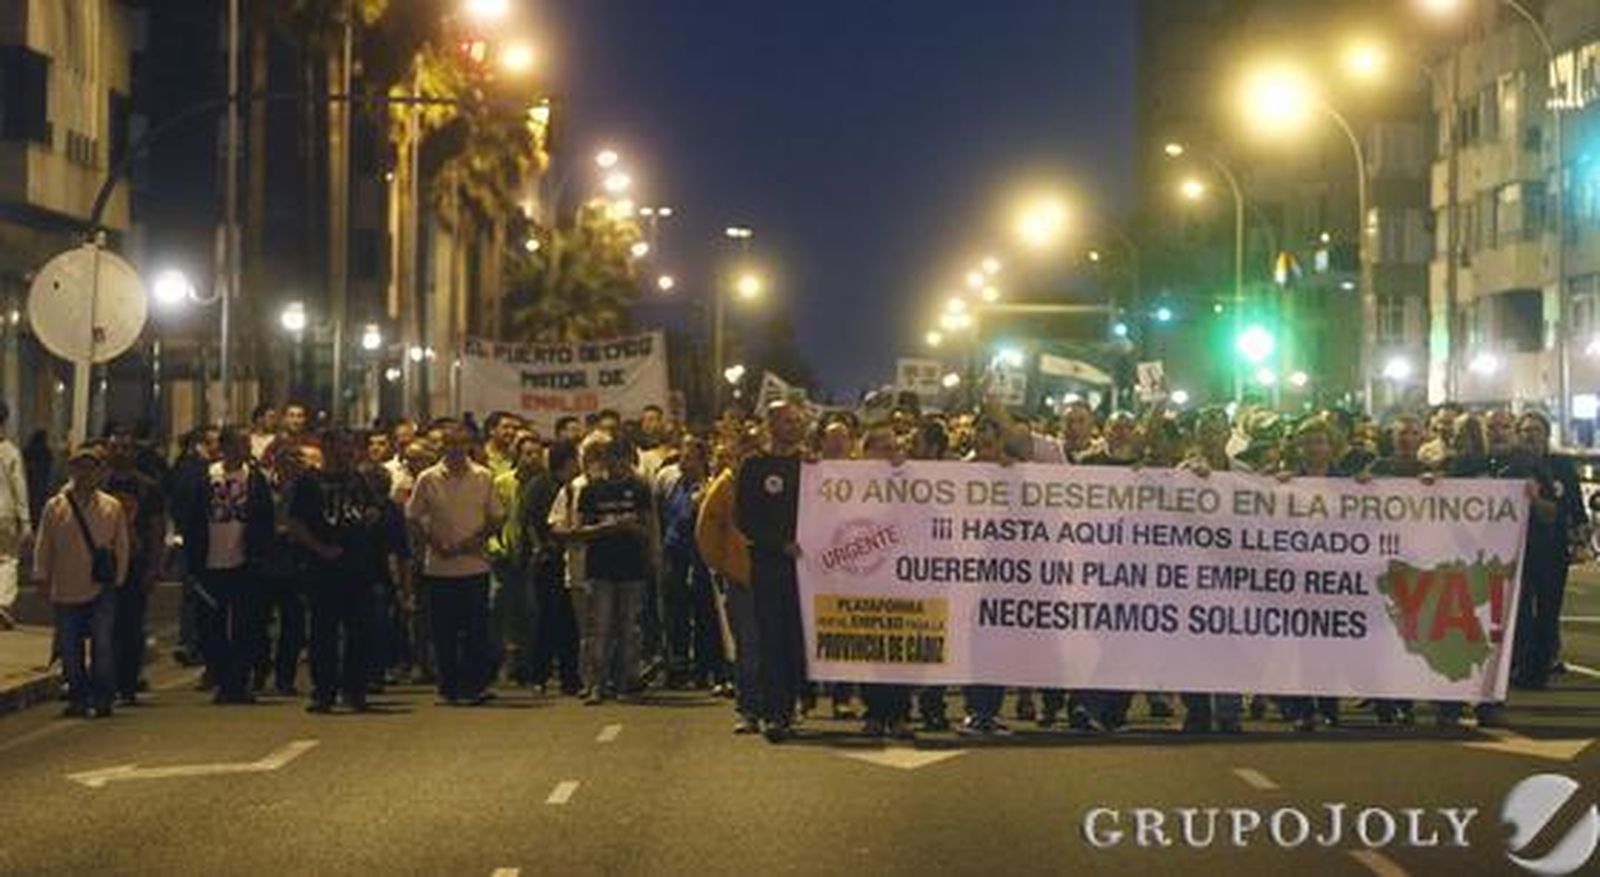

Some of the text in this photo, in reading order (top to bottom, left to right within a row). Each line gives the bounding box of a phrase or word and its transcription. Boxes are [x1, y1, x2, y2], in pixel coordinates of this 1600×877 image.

[966, 480, 1013, 506] DE
[1021, 482, 1221, 514] DESEMPLEO
[1232, 490, 1276, 516] EN
[1289, 492, 1330, 519] LA
[1339, 494, 1518, 523] PROVINCIA
[821, 524, 900, 571] URGENTE
[962, 519, 1050, 543] HASTA
[1056, 518, 1123, 546] AQUÍ
[1132, 523, 1232, 549] HEMOS
[1240, 529, 1371, 555] LLEGADO
[896, 555, 1369, 596] QUEREMOS UN PLAN DE EMPLEO REAL
[837, 599, 924, 613] PLATAFORMA
[978, 600, 1368, 640] NECESITAMOS SOLUCIONES
[1390, 569, 1506, 643] YA!
[816, 632, 885, 662] PROVINCIA
[888, 635, 903, 662] DE
